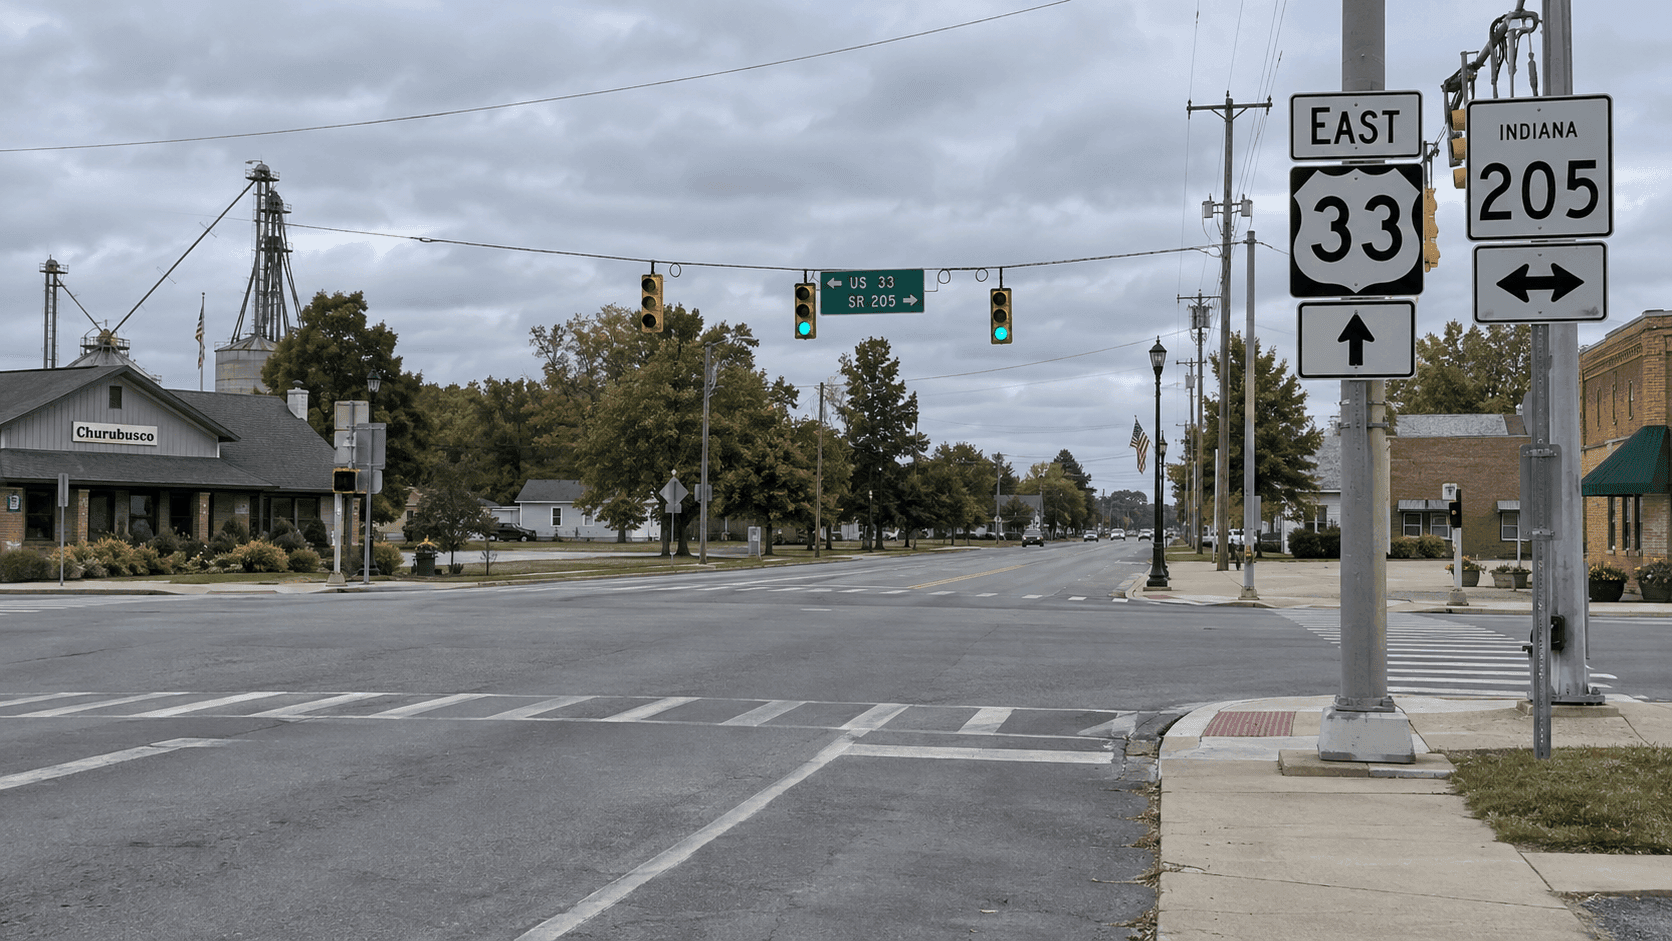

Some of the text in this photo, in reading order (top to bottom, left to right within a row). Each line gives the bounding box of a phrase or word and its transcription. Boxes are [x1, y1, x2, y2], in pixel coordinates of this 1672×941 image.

[1311, 106, 1401, 145] EAST
[1499, 120, 1578, 141] INDIANA
[1479, 159, 1599, 221] 205
[1310, 194, 1403, 263] 33
[849, 275, 895, 290] US 33
[848, 294, 896, 309] SR 205
[76, 425, 155, 442] Churubusco
